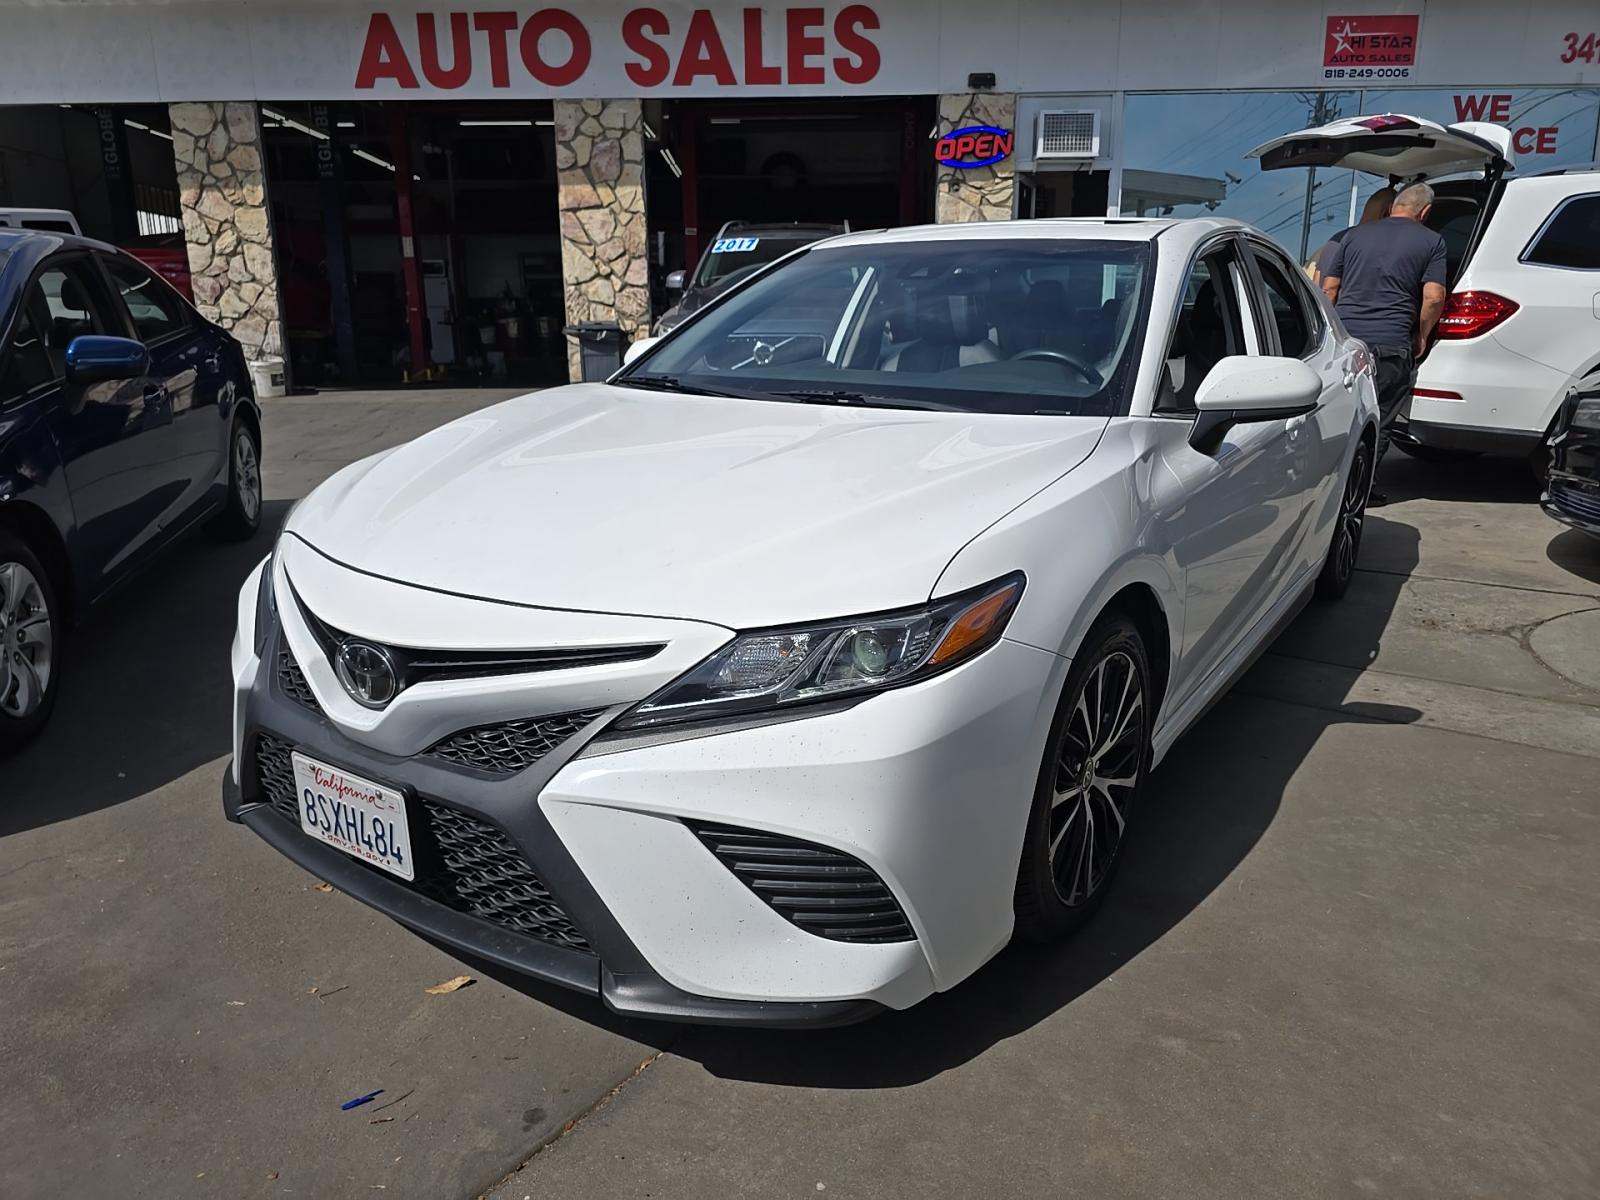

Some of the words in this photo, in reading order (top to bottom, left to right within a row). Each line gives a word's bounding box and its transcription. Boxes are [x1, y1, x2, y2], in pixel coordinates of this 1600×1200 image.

[355, 8, 592, 89] AUTO
[622, 5, 881, 88] SALES
[1350, 35, 1366, 49] HI
[1369, 35, 1413, 49] STAR
[1330, 54, 1366, 63] AUTO
[1368, 54, 1411, 63] SALES
[1324, 68, 1409, 78] 818-249-0006
[1453, 95, 1512, 122] WE
[934, 132, 1014, 160] OPEN
[714, 238, 757, 251] 2017
[314, 767, 385, 811] California
[303, 788, 403, 864] 8SXH484
[327, 835, 385, 865] dmv.ca.gov
